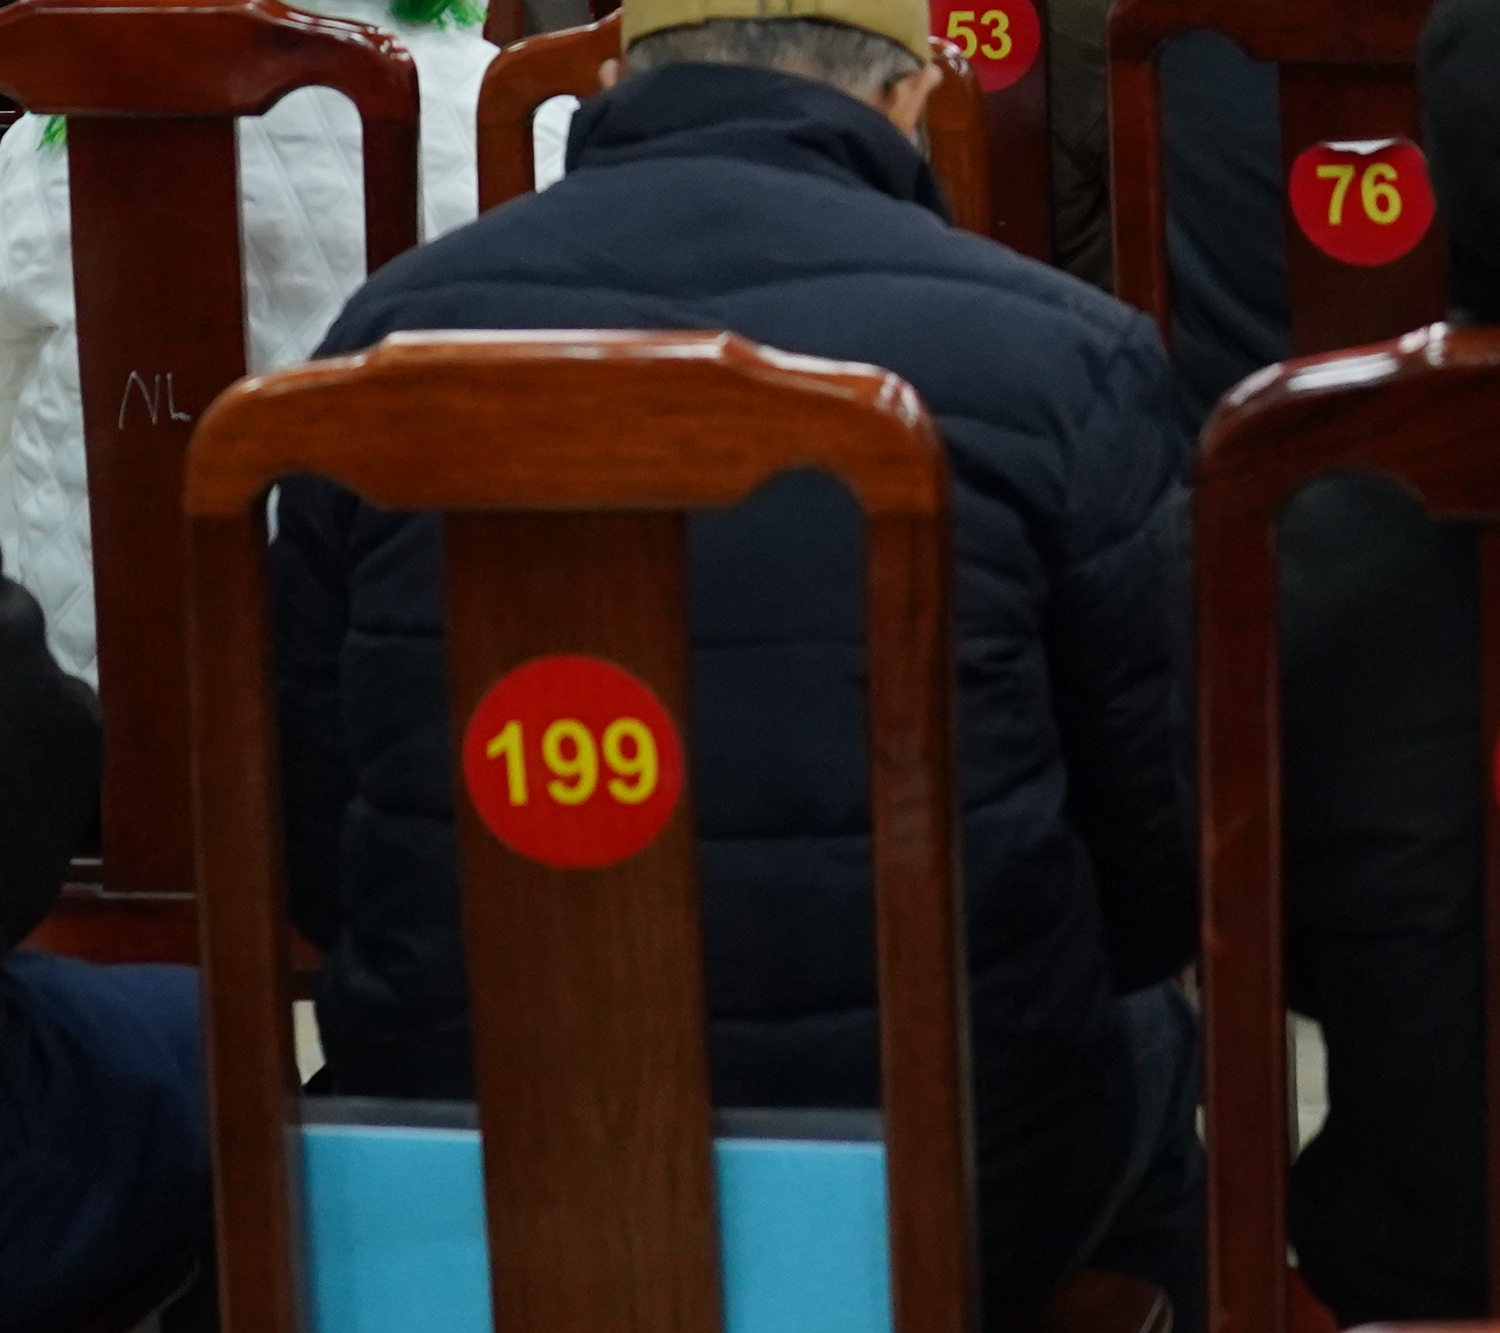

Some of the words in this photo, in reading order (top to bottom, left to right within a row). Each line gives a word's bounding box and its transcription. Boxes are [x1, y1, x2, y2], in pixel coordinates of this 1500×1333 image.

[946, 10, 1012, 60] 53
[1316, 164, 1402, 224] 76
[486, 719, 659, 806] 199
